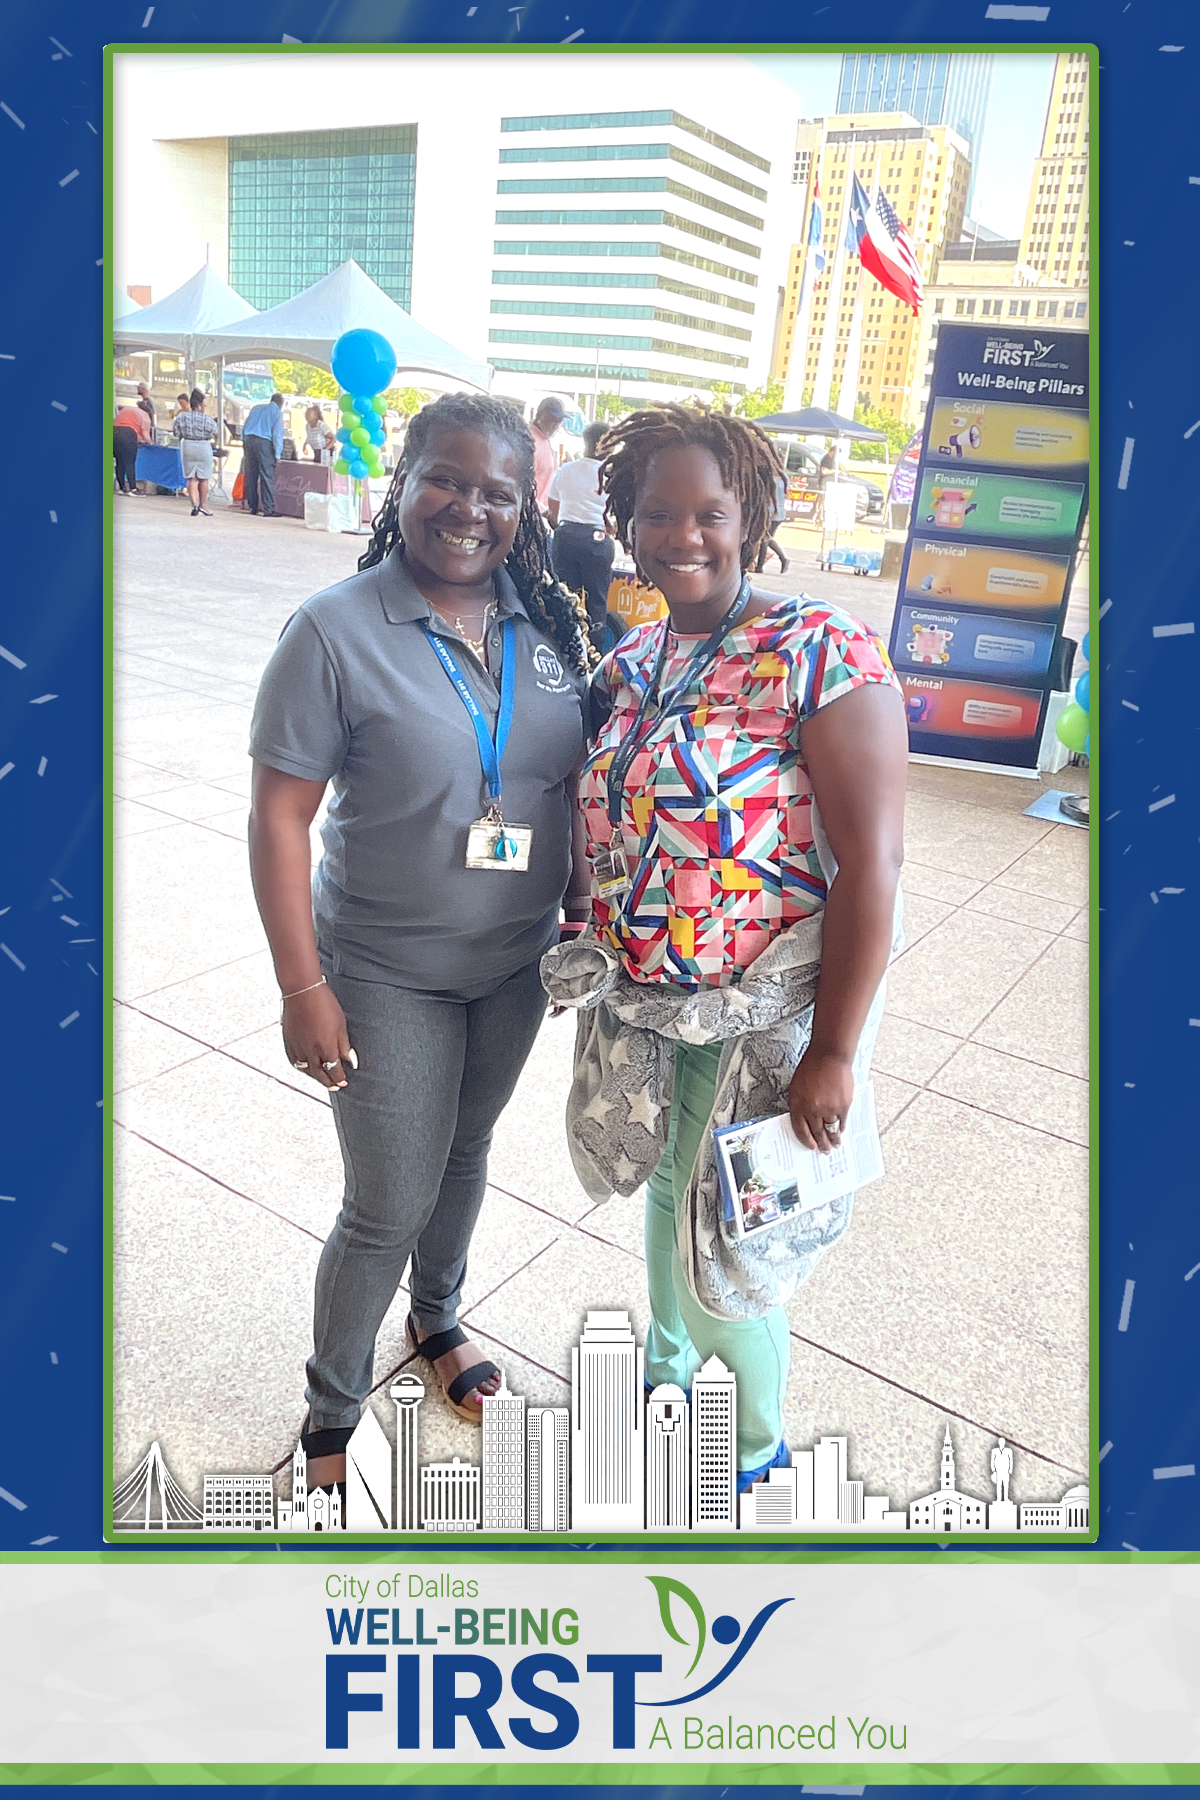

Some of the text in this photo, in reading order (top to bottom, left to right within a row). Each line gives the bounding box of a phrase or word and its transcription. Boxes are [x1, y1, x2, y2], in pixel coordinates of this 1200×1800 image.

[983, 348, 1035, 367] FIRST
[957, 372, 1085, 396] Well-Being Pillars
[953, 402, 985, 415] Social
[934, 473, 979, 487] Financial
[924, 543, 967, 558] Physical
[910, 610, 959, 625] Community
[433, 637, 457, 673] DALLAS 311
[906, 676, 943, 690] Mental
[457, 679, 479, 716] DALLAS 311
